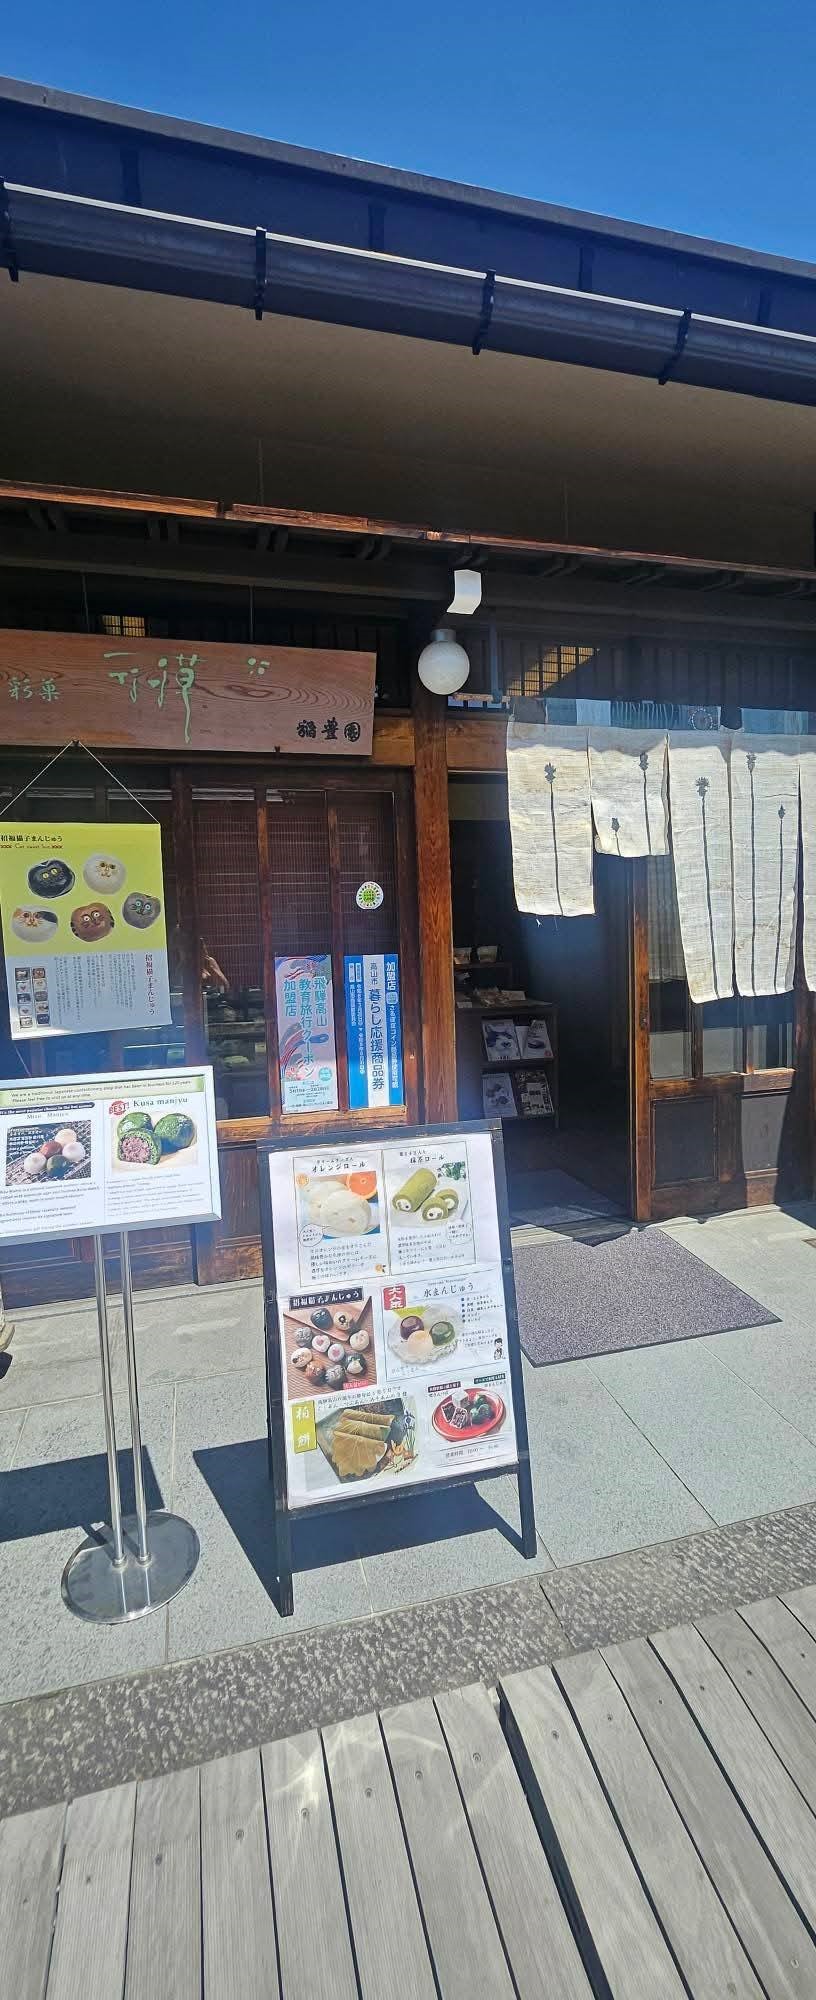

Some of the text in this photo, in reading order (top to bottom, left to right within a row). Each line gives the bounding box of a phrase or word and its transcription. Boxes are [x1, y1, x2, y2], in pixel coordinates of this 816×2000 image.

[386, 961, 397, 991] 加盟店
[284, 980, 297, 1017] 加盟店
[299, 978, 315, 1078] 教育旅行クーポン
[369, 988, 385, 1090] 暮らし応援商品券
[312, 1161, 366, 1173] オレンジロール
